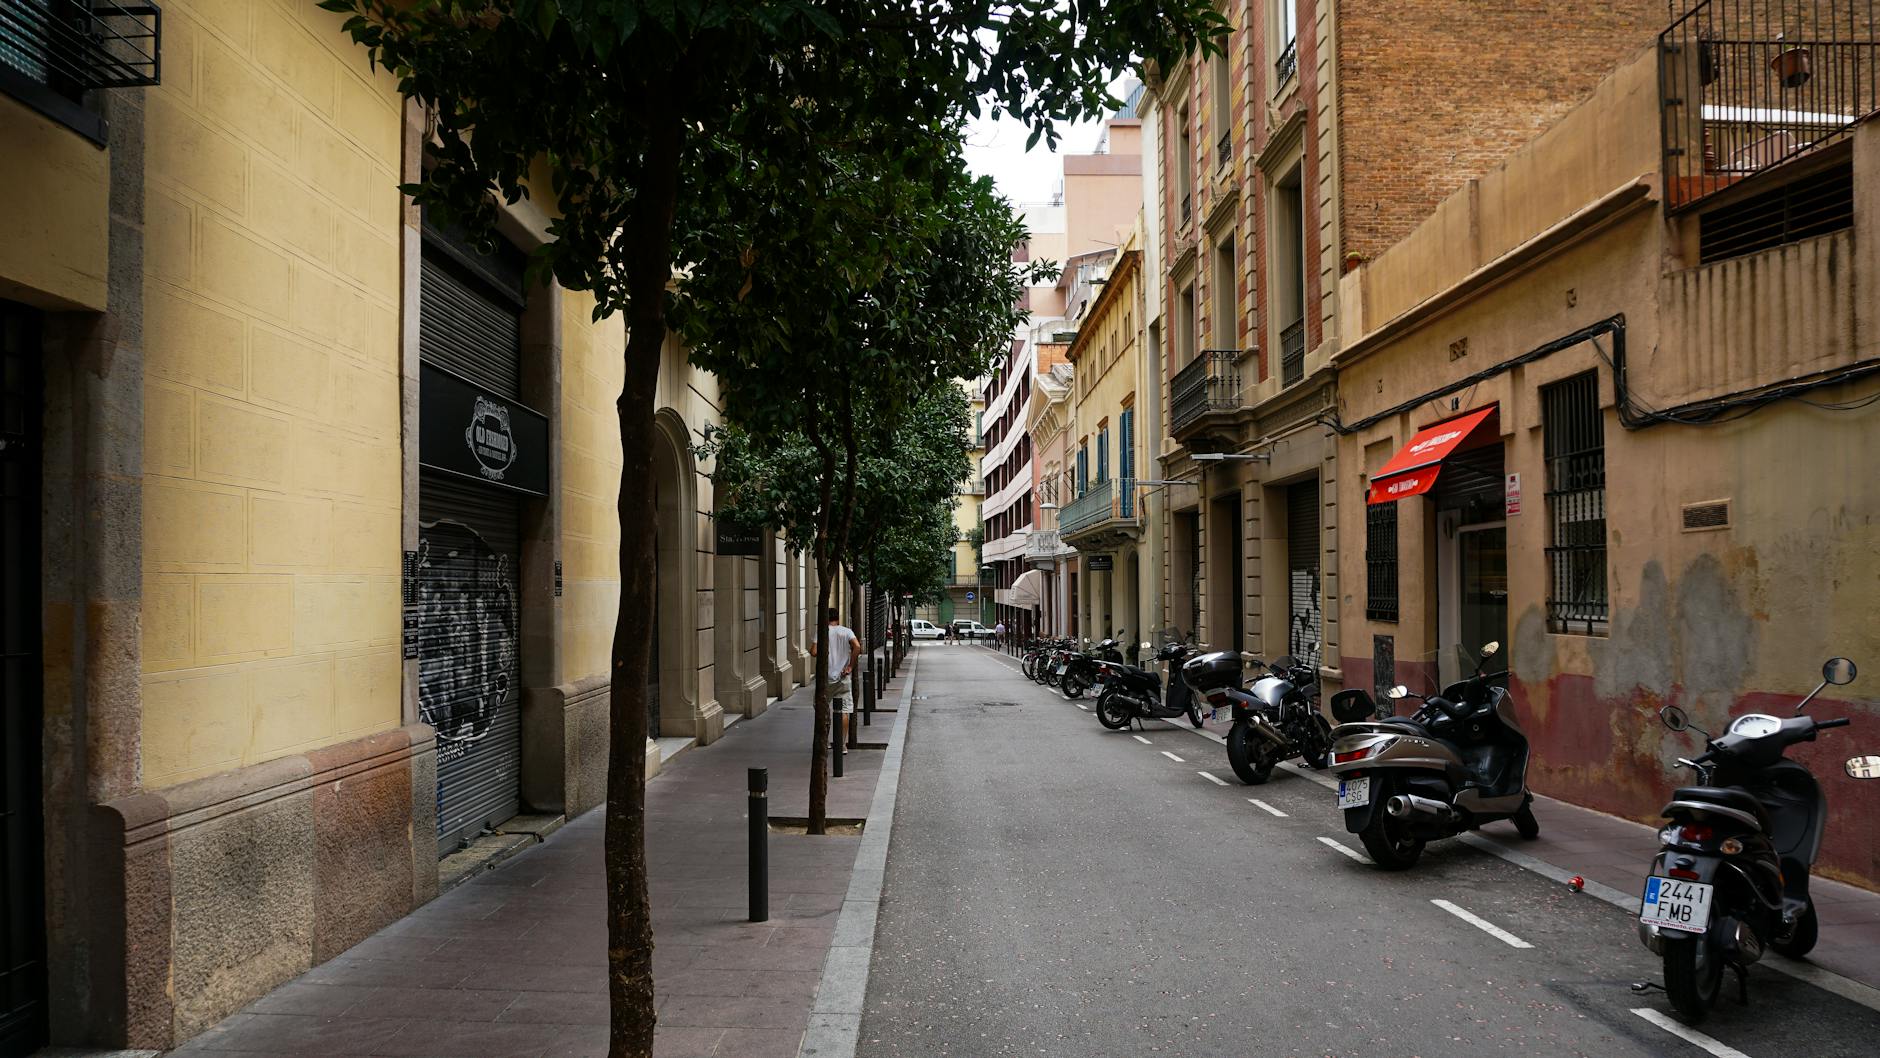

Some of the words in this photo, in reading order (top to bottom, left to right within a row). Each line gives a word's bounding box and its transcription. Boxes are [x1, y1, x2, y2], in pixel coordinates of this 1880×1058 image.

[1345, 791, 1362, 803] CSG
[1660, 881, 1704, 904] 2441
[1657, 901, 1692, 922] FMB
